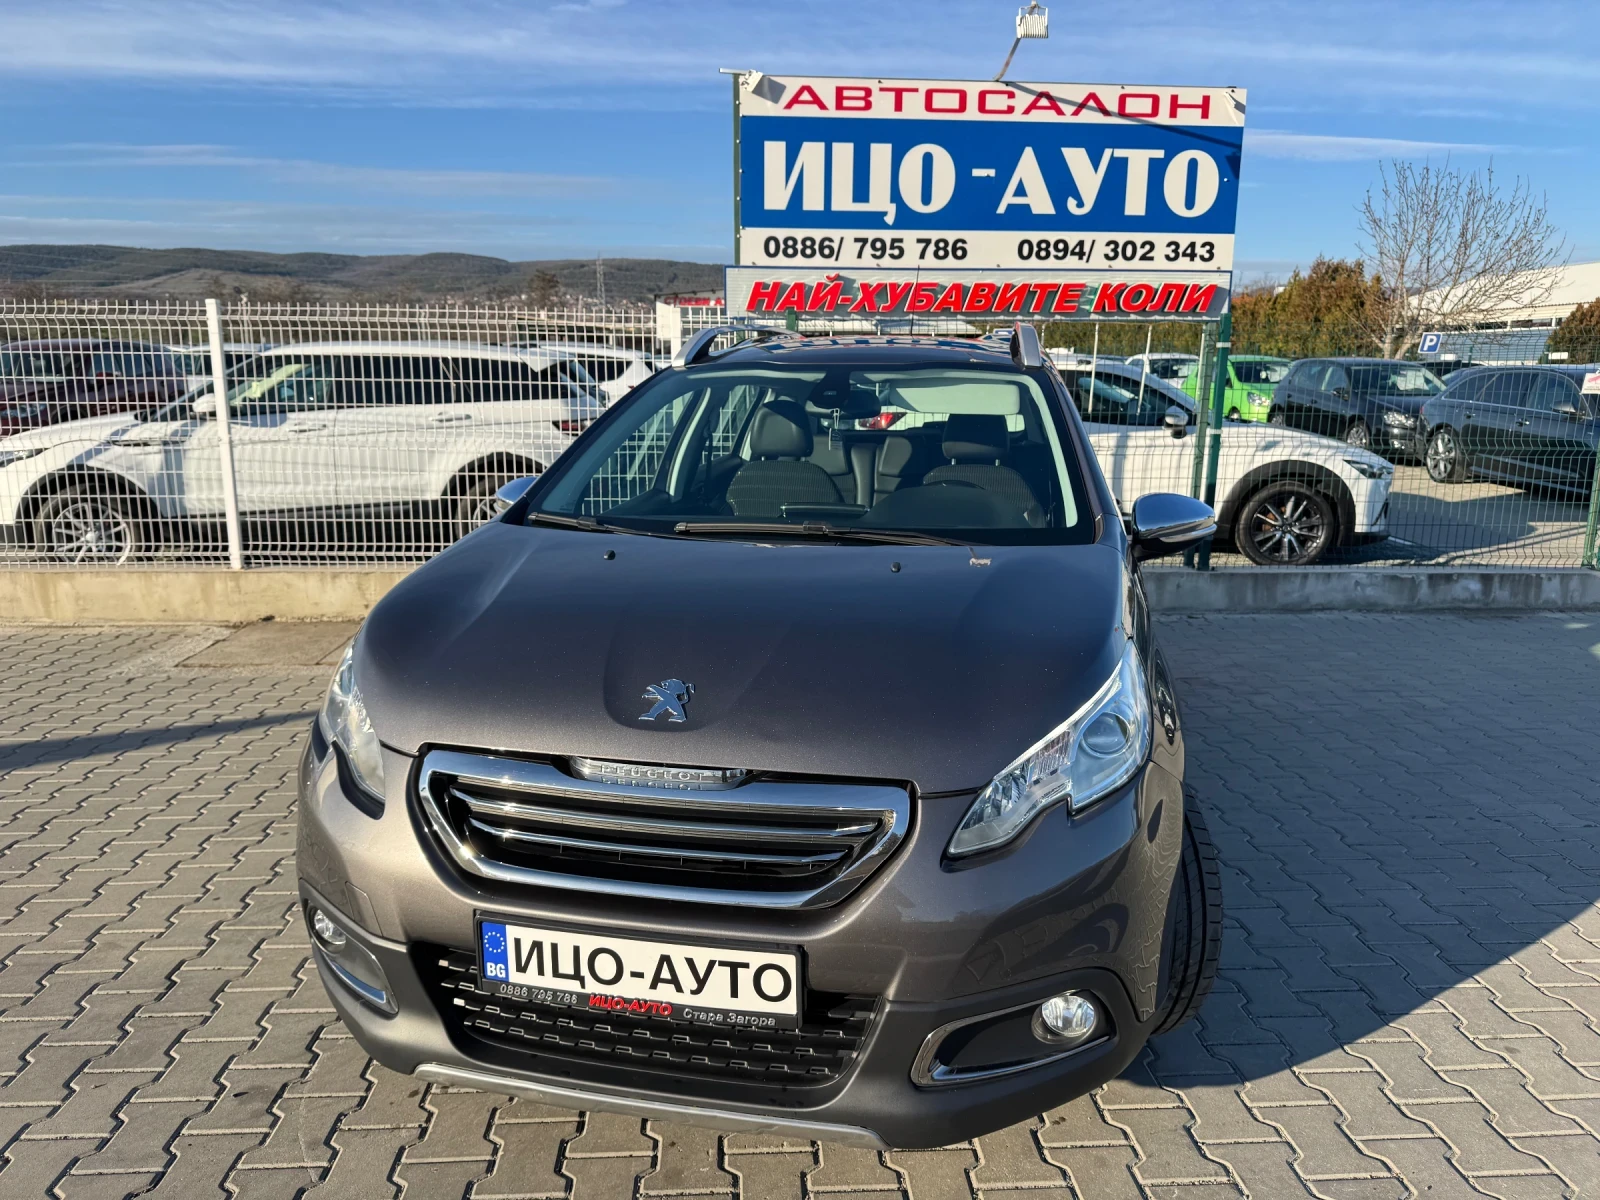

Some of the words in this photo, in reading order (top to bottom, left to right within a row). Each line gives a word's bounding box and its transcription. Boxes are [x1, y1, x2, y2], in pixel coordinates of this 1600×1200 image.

[783, 84, 1211, 120] АВТОСАЛОН
[763, 235, 845, 262] 0886/
[853, 237, 905, 260] 795
[915, 238, 969, 261] 786
[1017, 238, 1096, 264] 0894/
[1103, 240, 1156, 262] 302
[1164, 241, 1216, 263] 343
[745, 272, 1087, 314] НАЙ-ХУБАВИТЕ
[1090, 282, 1218, 314] КОЛИ
[1423, 335, 1437, 351] P
[486, 961, 506, 979] BG
[513, 936, 793, 1003] ИЦО-АУТО
[500, 983, 528, 997] 0886
[557, 991, 578, 1004] 786
[588, 993, 673, 1017] ИЦО-АУТО
[682, 1007, 724, 1023] Стара
[726, 1012, 776, 1027] Загора
